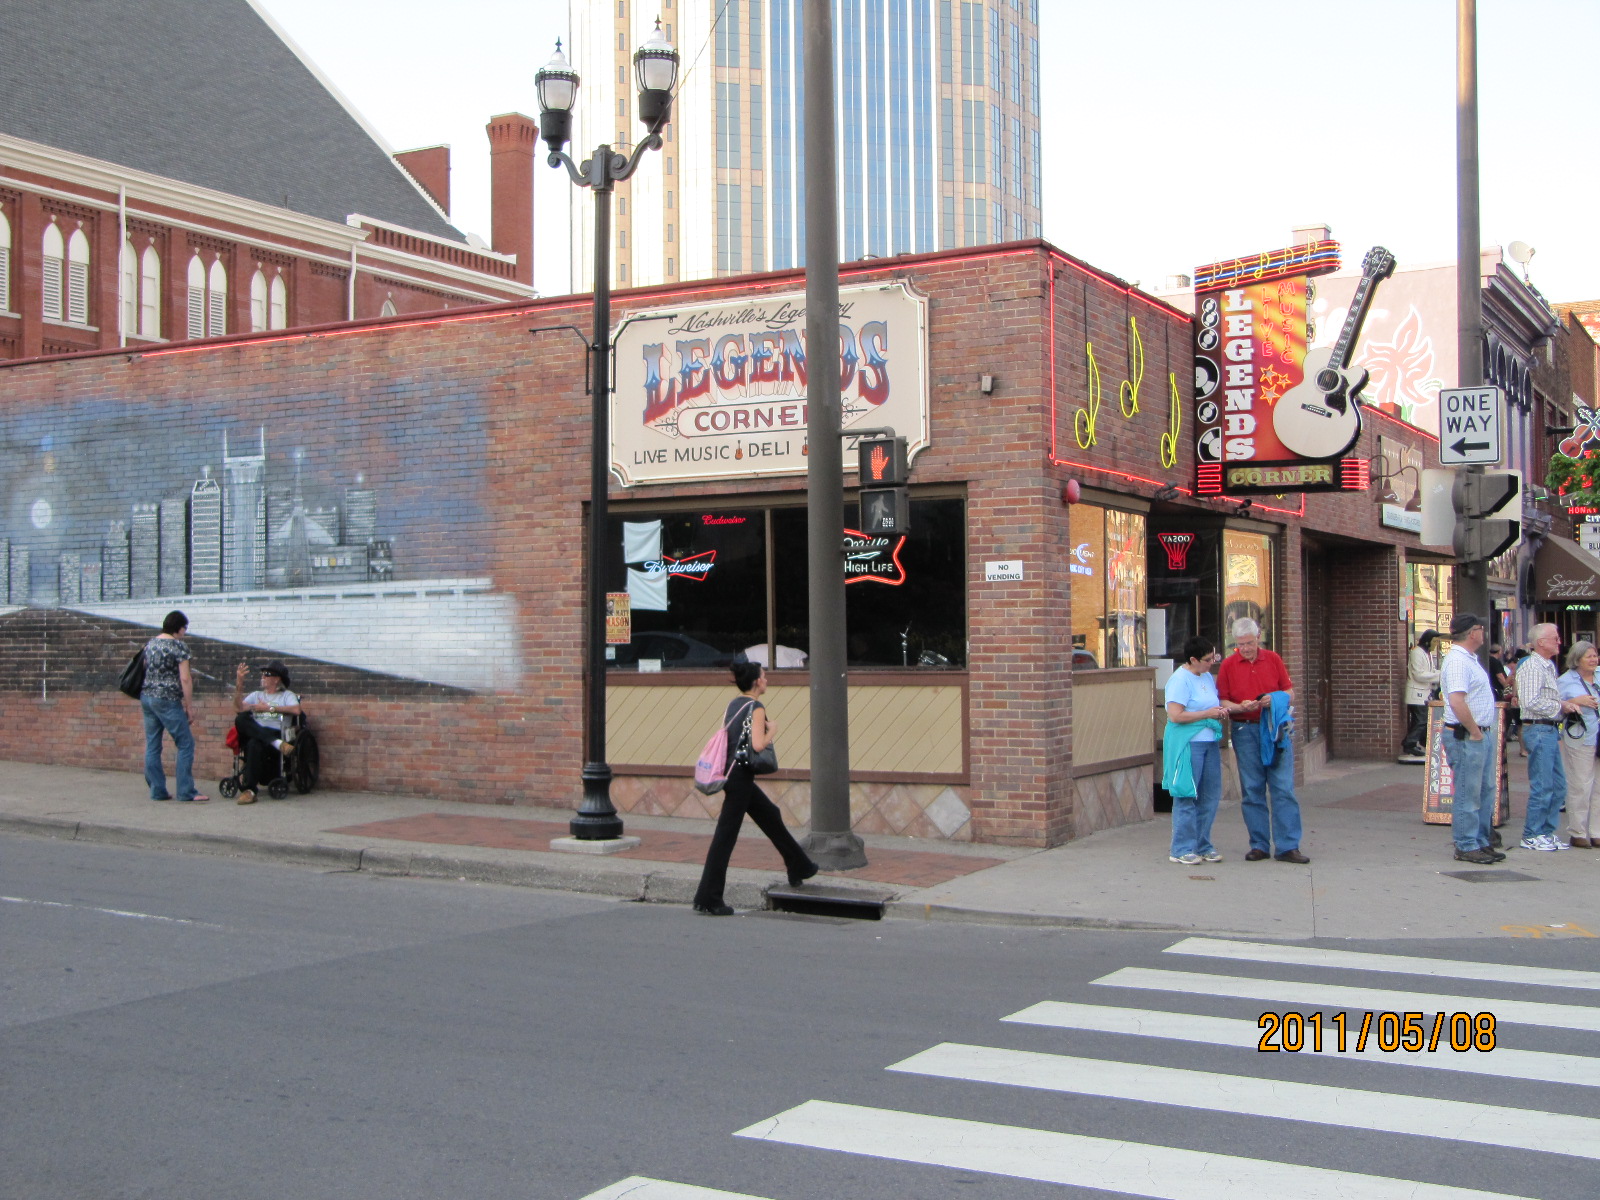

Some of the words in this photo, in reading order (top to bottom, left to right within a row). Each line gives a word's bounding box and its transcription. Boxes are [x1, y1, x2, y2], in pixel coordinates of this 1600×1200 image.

[668, 308, 767, 335] Nashville's
[1259, 287, 1273, 357] LIVE
[1277, 281, 1296, 364] MUSIC
[1224, 290, 1256, 461] LEGENDS
[1446, 393, 1491, 412] ONE
[694, 404, 808, 432] CORNE
[1446, 414, 1493, 433] WAY
[634, 447, 667, 465] LIVE
[674, 444, 730, 462] MUSIC
[748, 440, 790, 458] DELI
[1230, 468, 1331, 486] CORNER
[702, 514, 746, 525] Budweiser
[1162, 535, 1190, 543] YAZOO
[644, 560, 715, 573] Budweiser
[844, 560, 868, 573] HIGH
[871, 560, 893, 572] LIFE
[987, 573, 1021, 581] VENDING
[1546, 574, 1595, 587] Second
[1546, 585, 1597, 598] Fiddle
